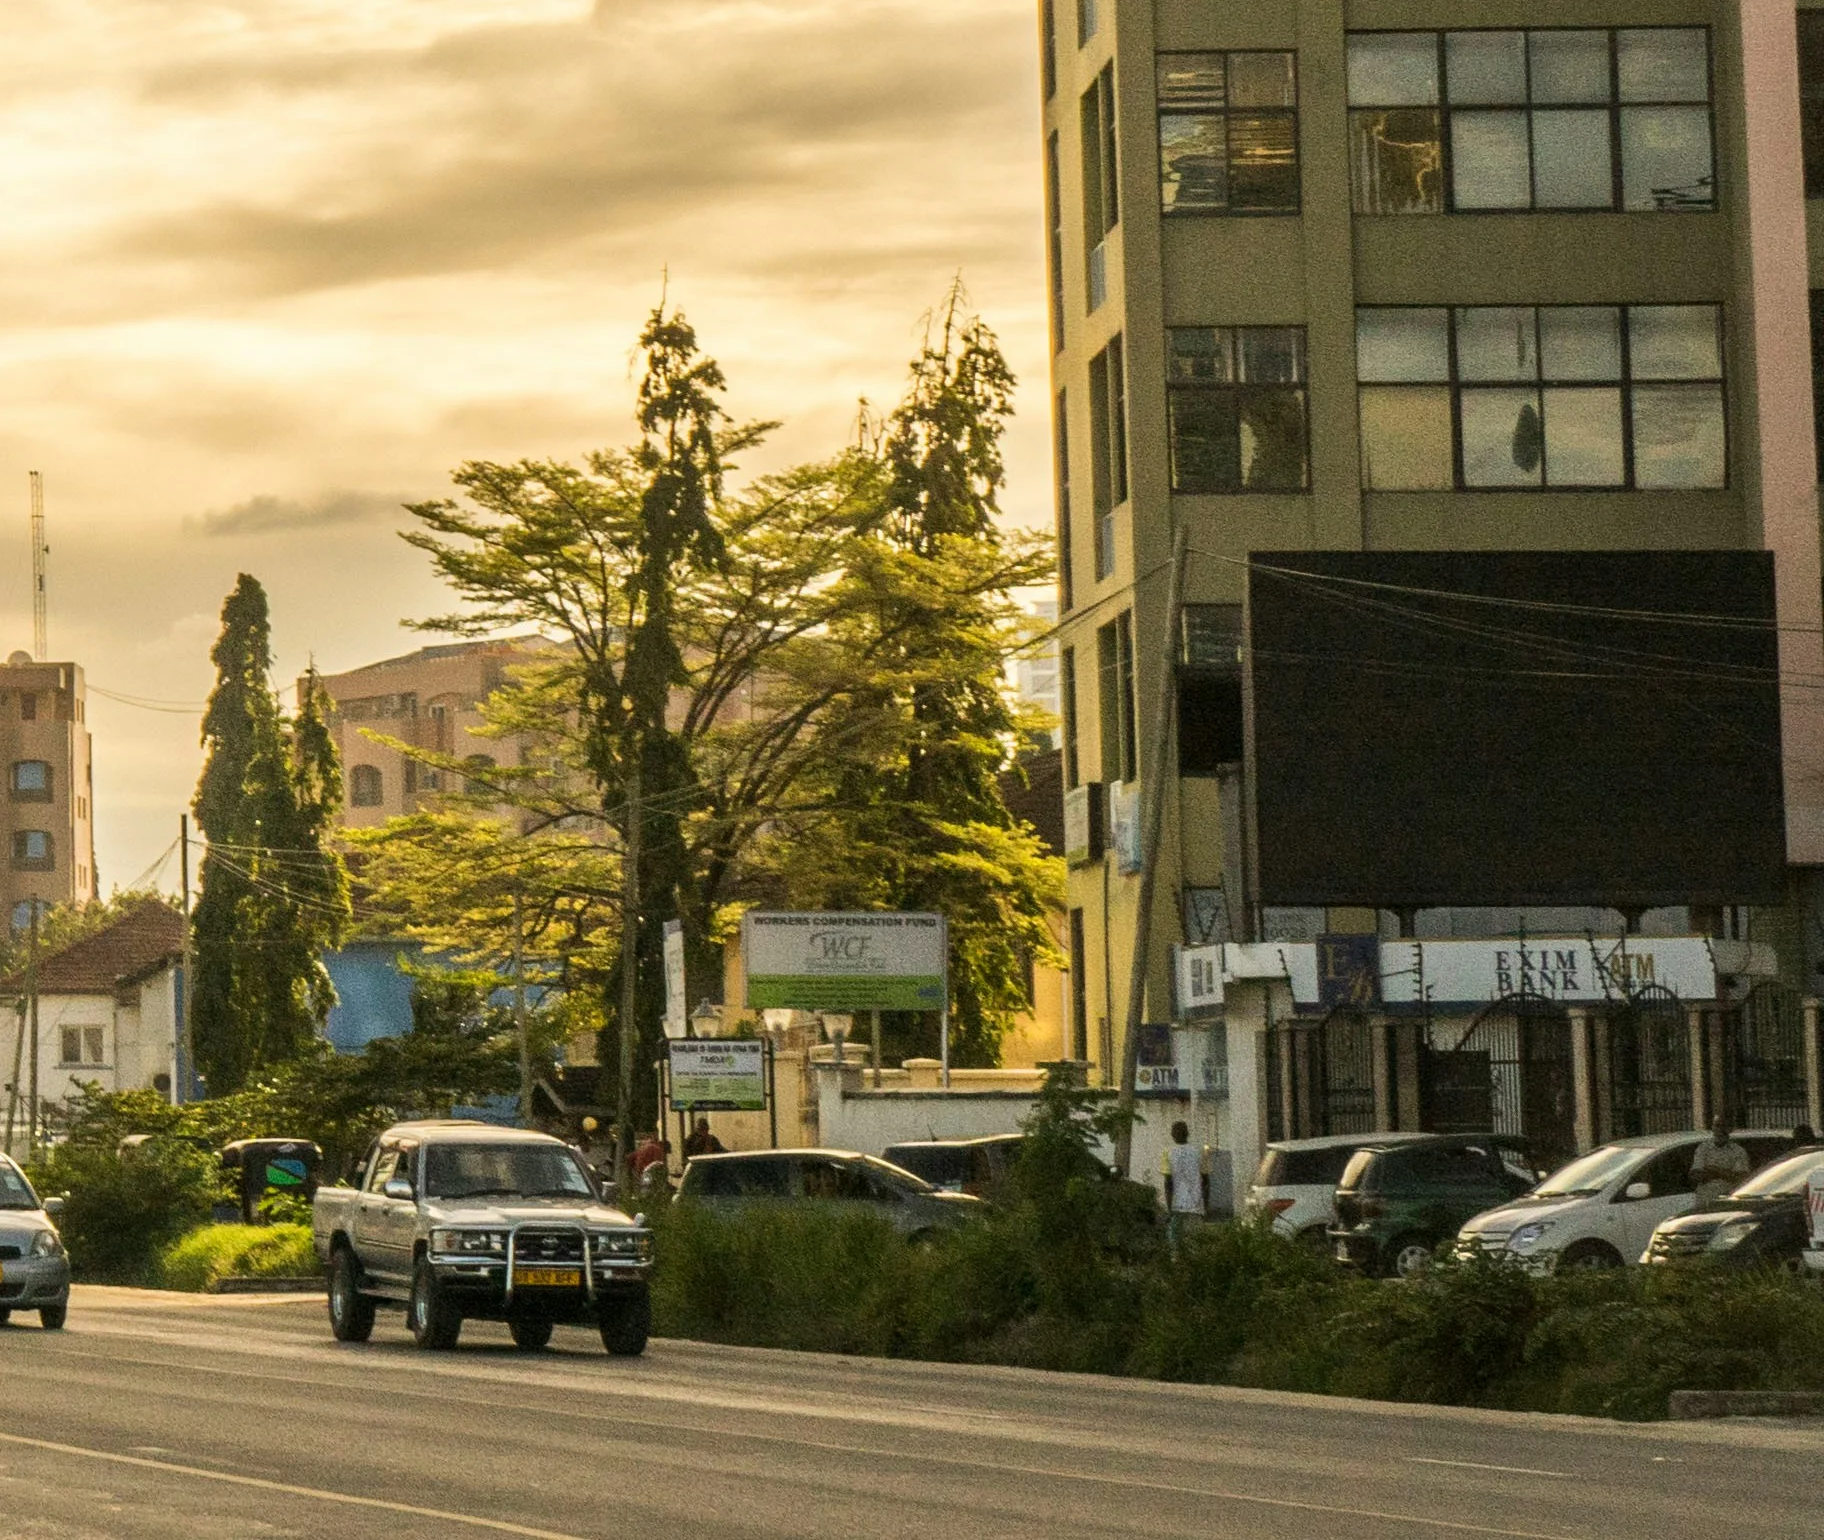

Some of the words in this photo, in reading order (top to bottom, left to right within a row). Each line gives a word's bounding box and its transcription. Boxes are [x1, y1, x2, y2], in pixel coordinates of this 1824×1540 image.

[754, 916, 810, 926] WORKERS
[813, 917, 902, 927] COMPENSATION
[905, 917, 937, 928] FUND
[809, 931, 872, 959] WCF
[1496, 950, 1577, 971] EXIM
[1496, 971, 1580, 992] BANK
[1152, 1068, 1179, 1086] ATM
